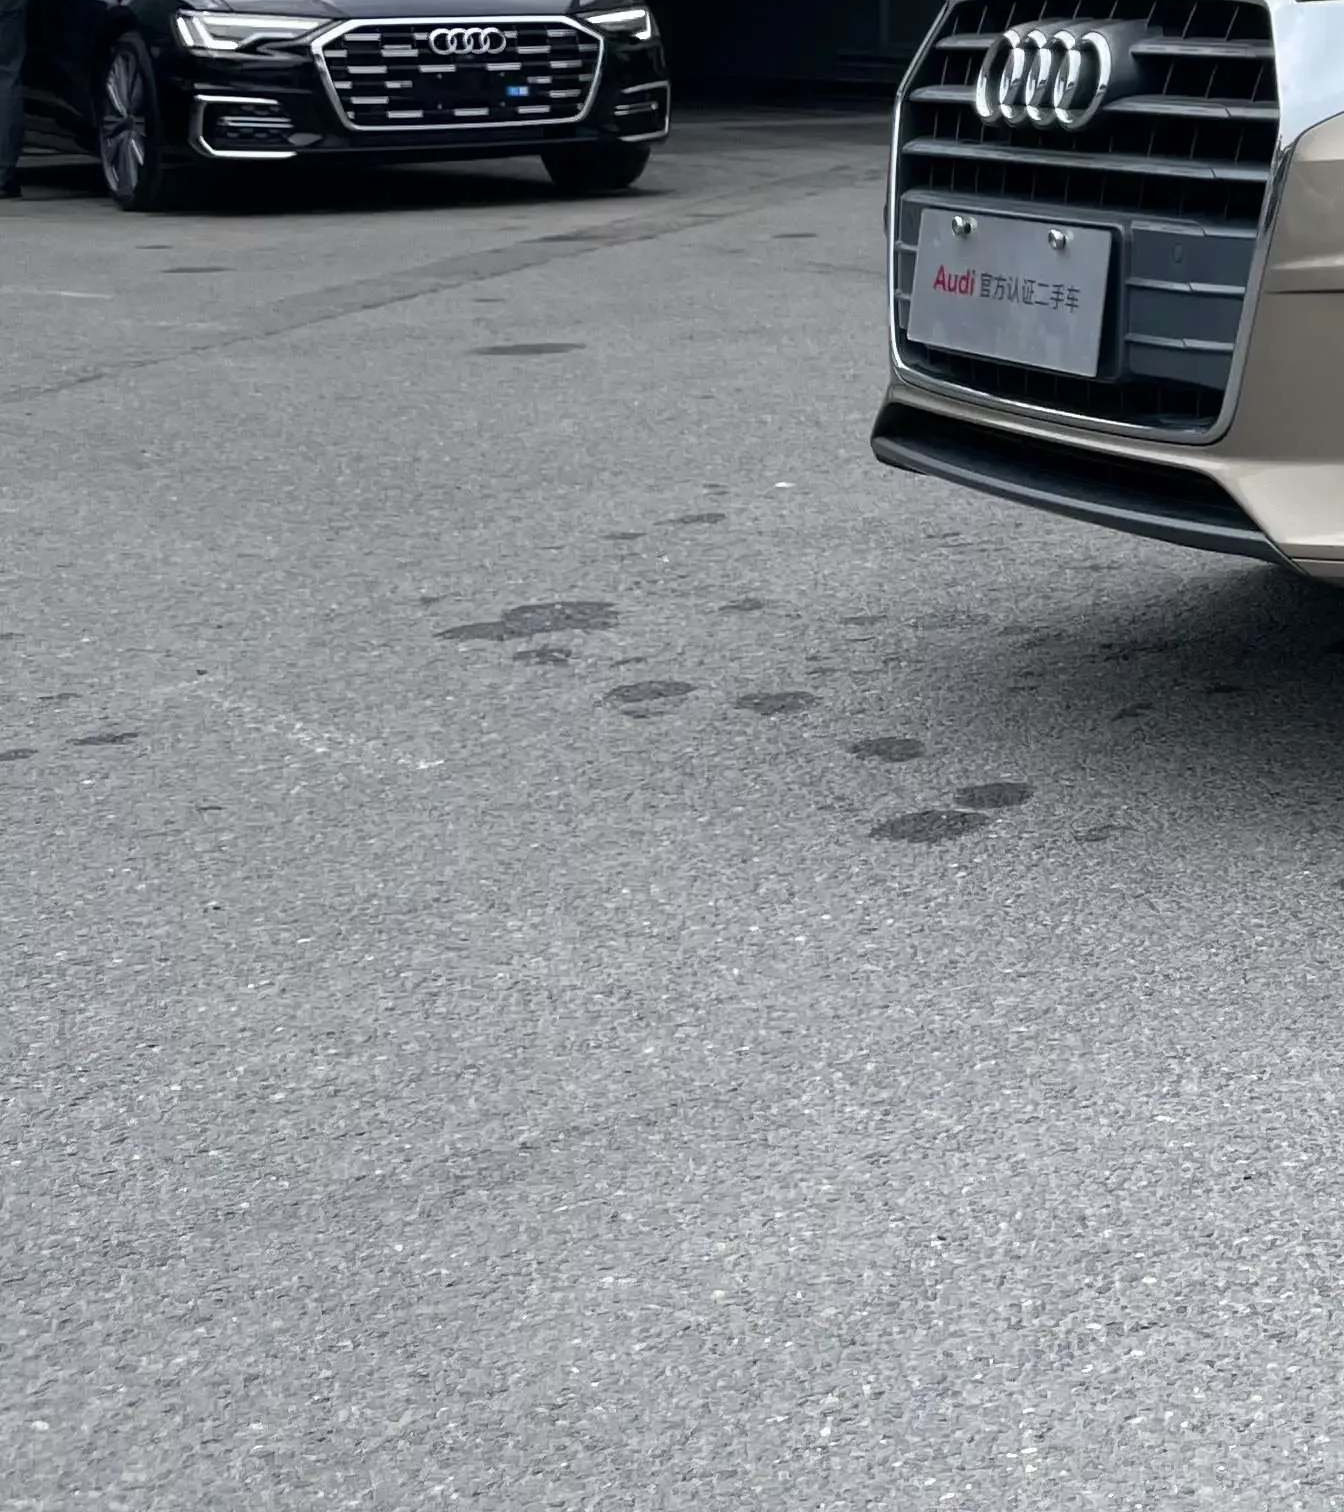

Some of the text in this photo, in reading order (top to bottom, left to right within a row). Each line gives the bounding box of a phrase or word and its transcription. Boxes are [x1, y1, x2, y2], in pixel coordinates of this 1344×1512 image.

[933, 264, 1081, 313] Audi 官方认证二手车
